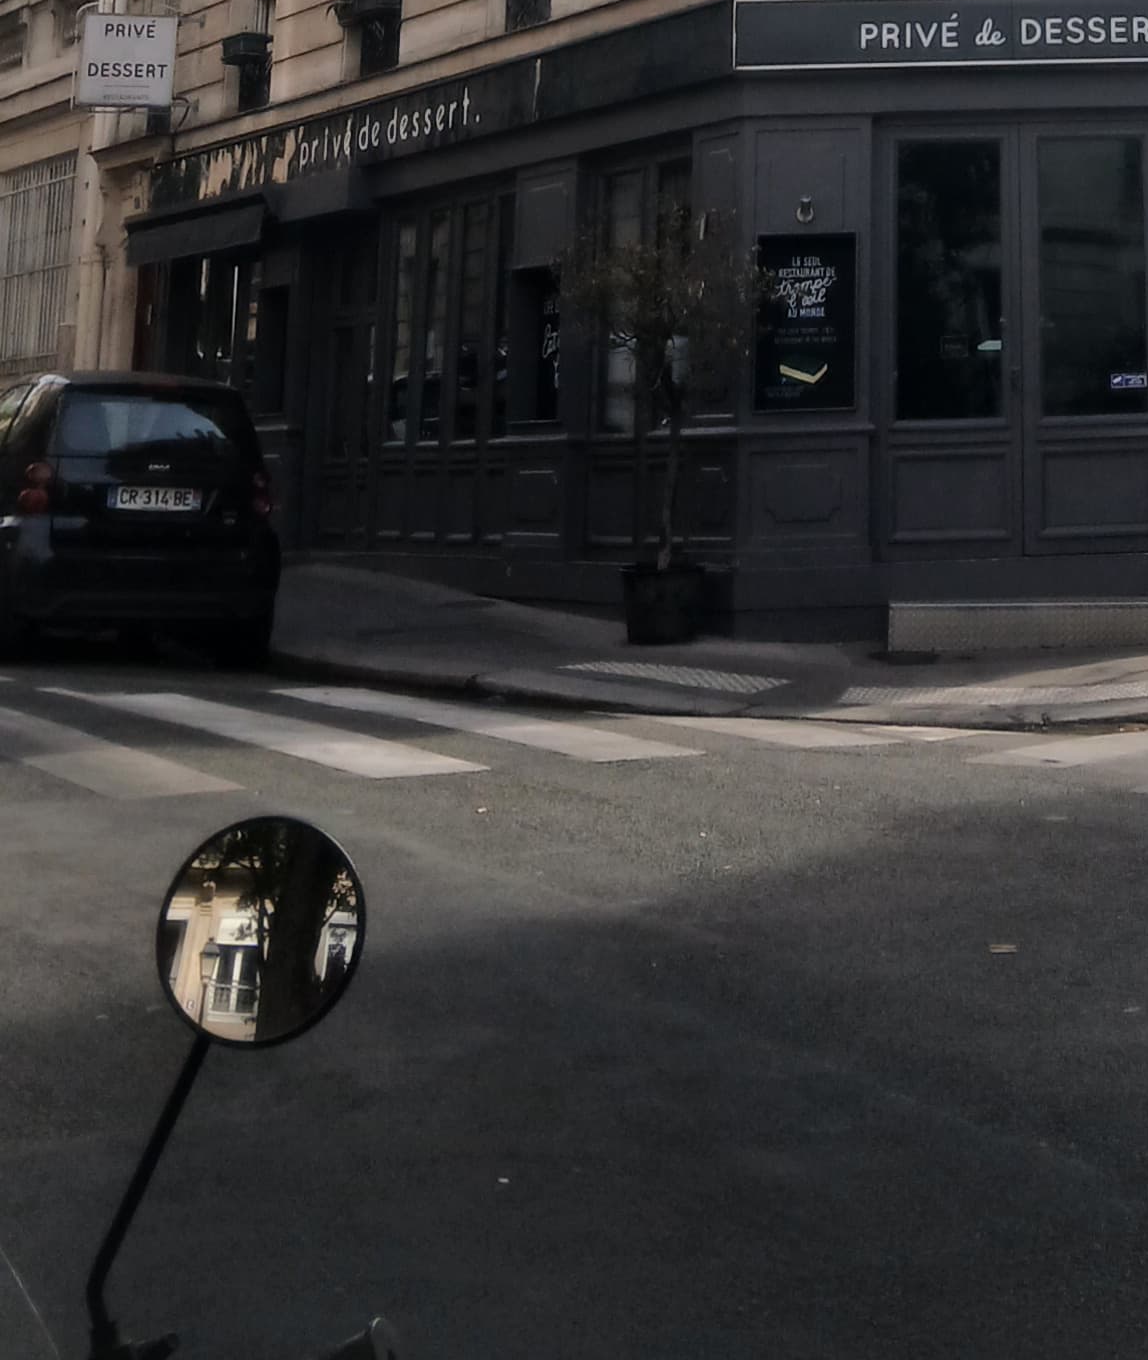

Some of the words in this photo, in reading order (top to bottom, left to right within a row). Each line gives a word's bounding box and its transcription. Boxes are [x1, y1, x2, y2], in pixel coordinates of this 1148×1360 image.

[104, 20, 156, 39] PRIVÉ
[860, 13, 960, 49] PRIVÉ
[975, 18, 1006, 47] de
[87, 62, 169, 79] DESSERT
[299, 118, 352, 171] privé
[358, 115, 380, 152] de
